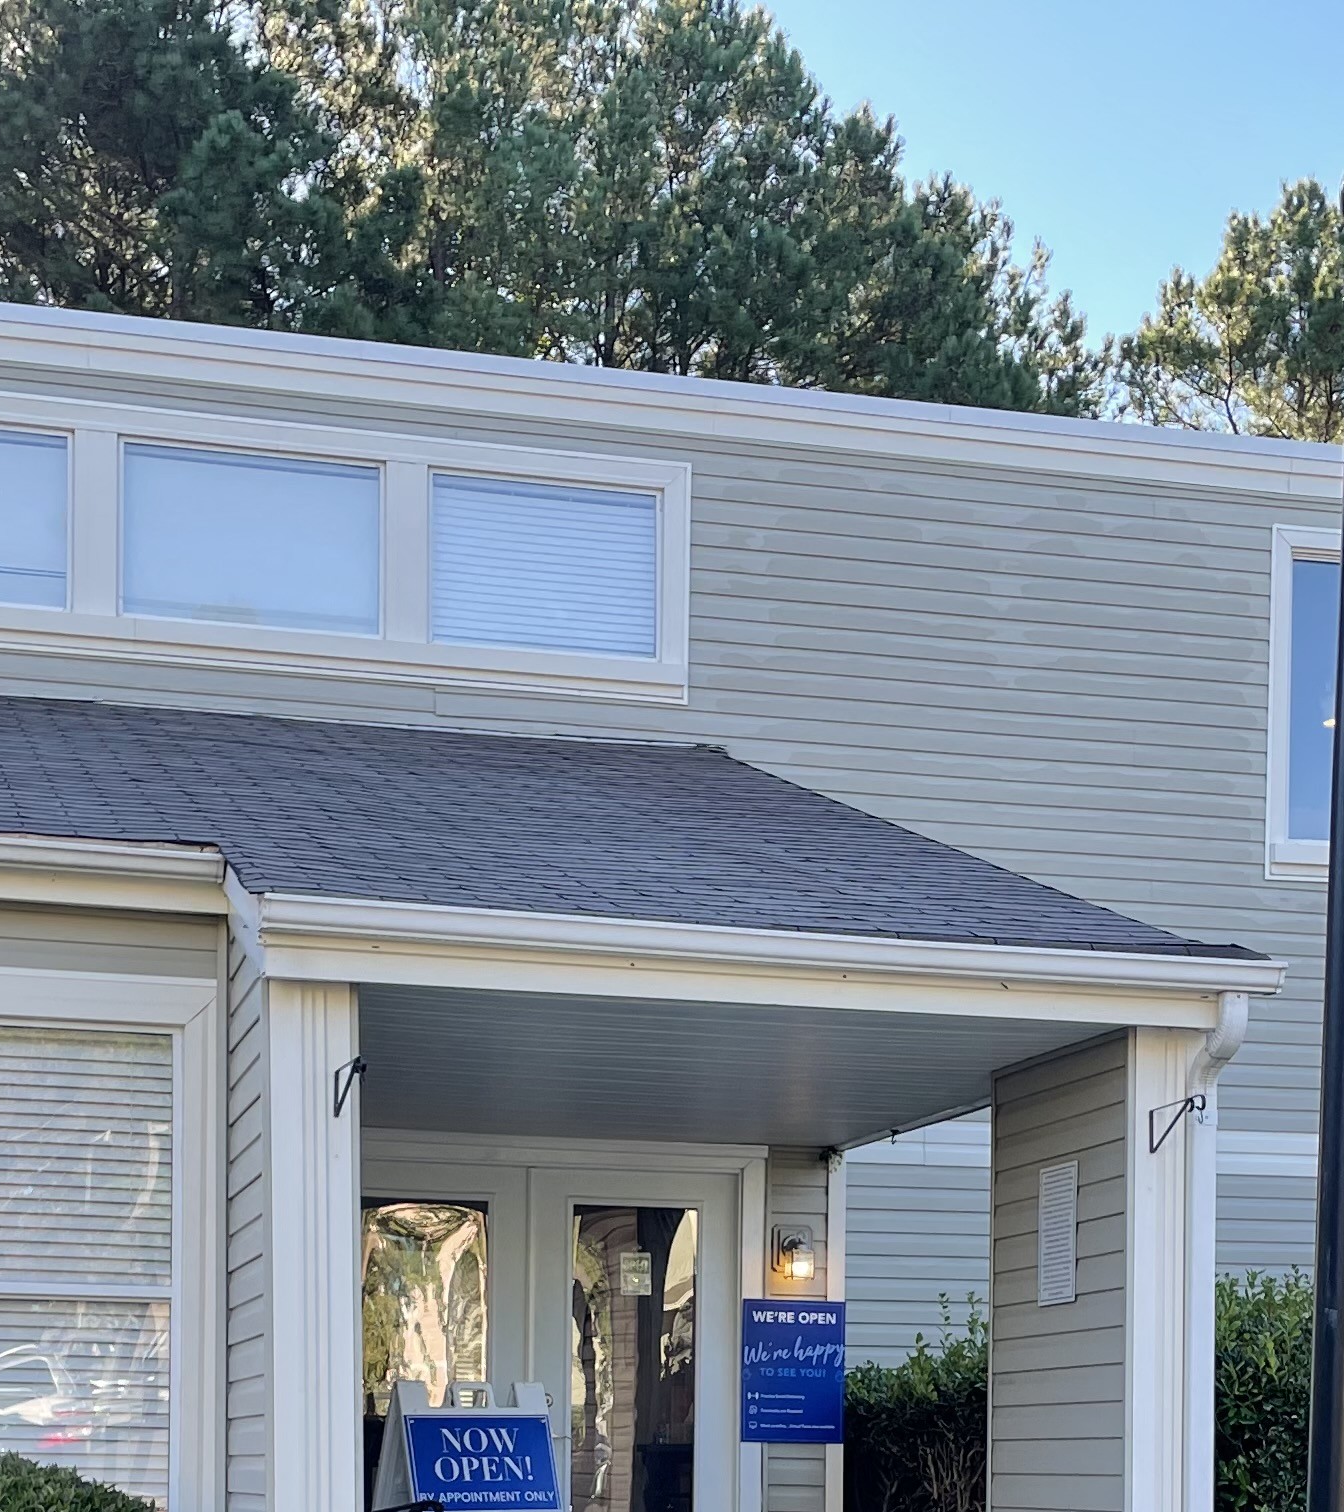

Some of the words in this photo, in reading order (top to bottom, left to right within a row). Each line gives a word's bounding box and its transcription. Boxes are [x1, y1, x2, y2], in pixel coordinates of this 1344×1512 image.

[752, 1310, 796, 1324] WE'RE
[798, 1312, 837, 1325] OPEN
[743, 1341, 792, 1366] We're
[793, 1335, 845, 1368] happy
[760, 1367, 775, 1377] TO
[777, 1368, 797, 1378] SEE
[799, 1368, 827, 1379] YOU!
[440, 1427, 519, 1454] NOW
[434, 1455, 534, 1483] OPEN!
[438, 1491, 521, 1503] APPOINTMENT
[524, 1490, 555, 1502] ONLY
